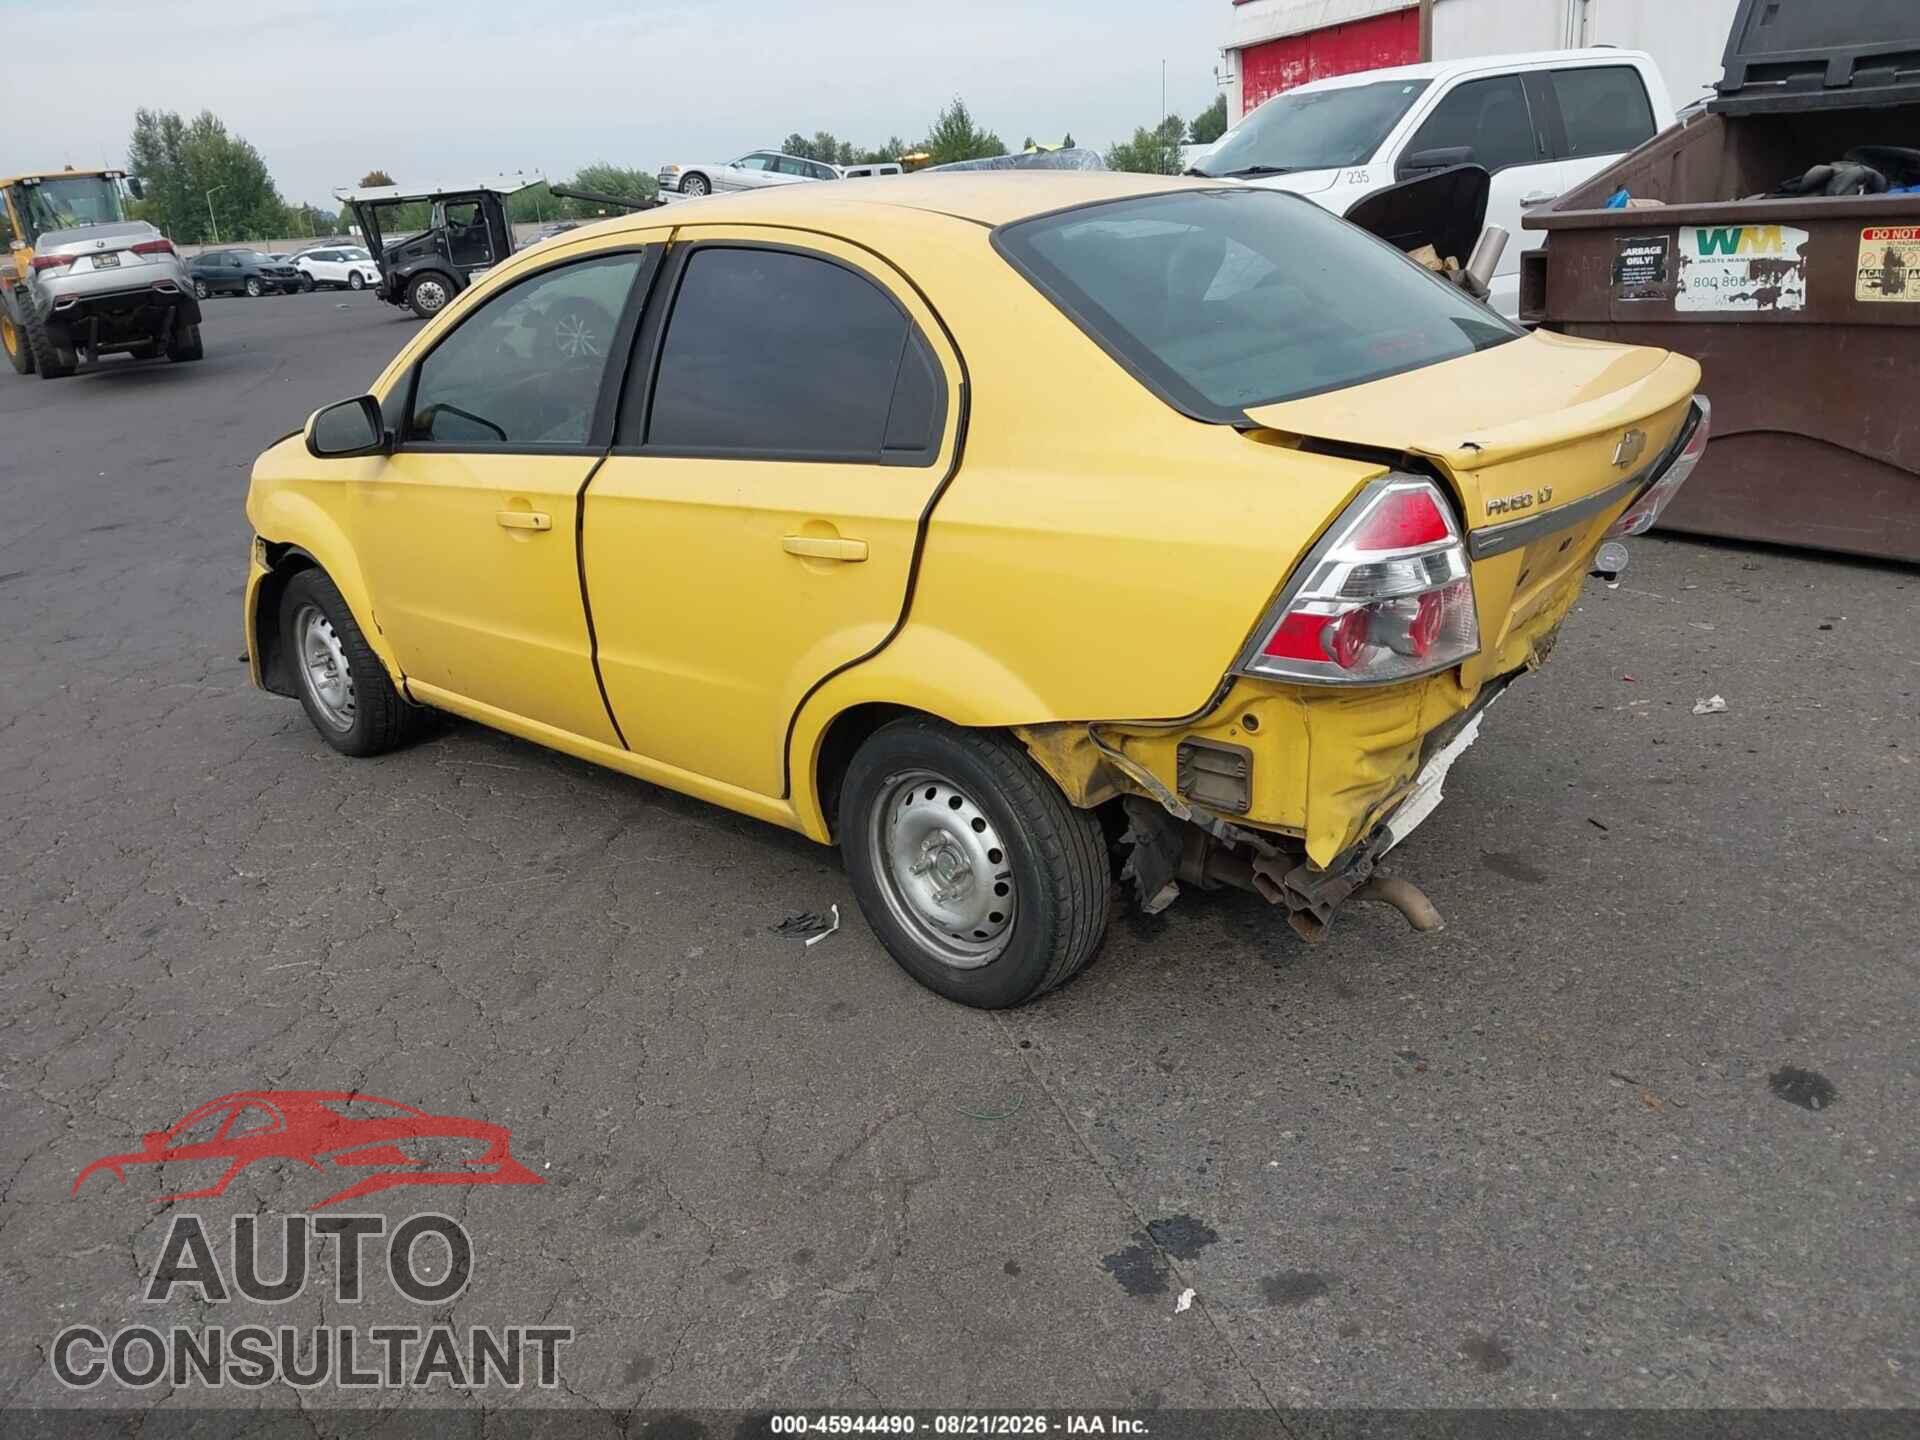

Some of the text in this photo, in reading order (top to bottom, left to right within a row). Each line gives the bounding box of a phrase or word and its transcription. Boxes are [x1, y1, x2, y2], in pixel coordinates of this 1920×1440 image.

[1346, 170, 1369, 184] 235
[1696, 227, 1782, 255] WM
[1872, 229, 1919, 240] DO NOT
[1694, 277, 1718, 288] 800
[1722, 276, 1746, 287] 808
